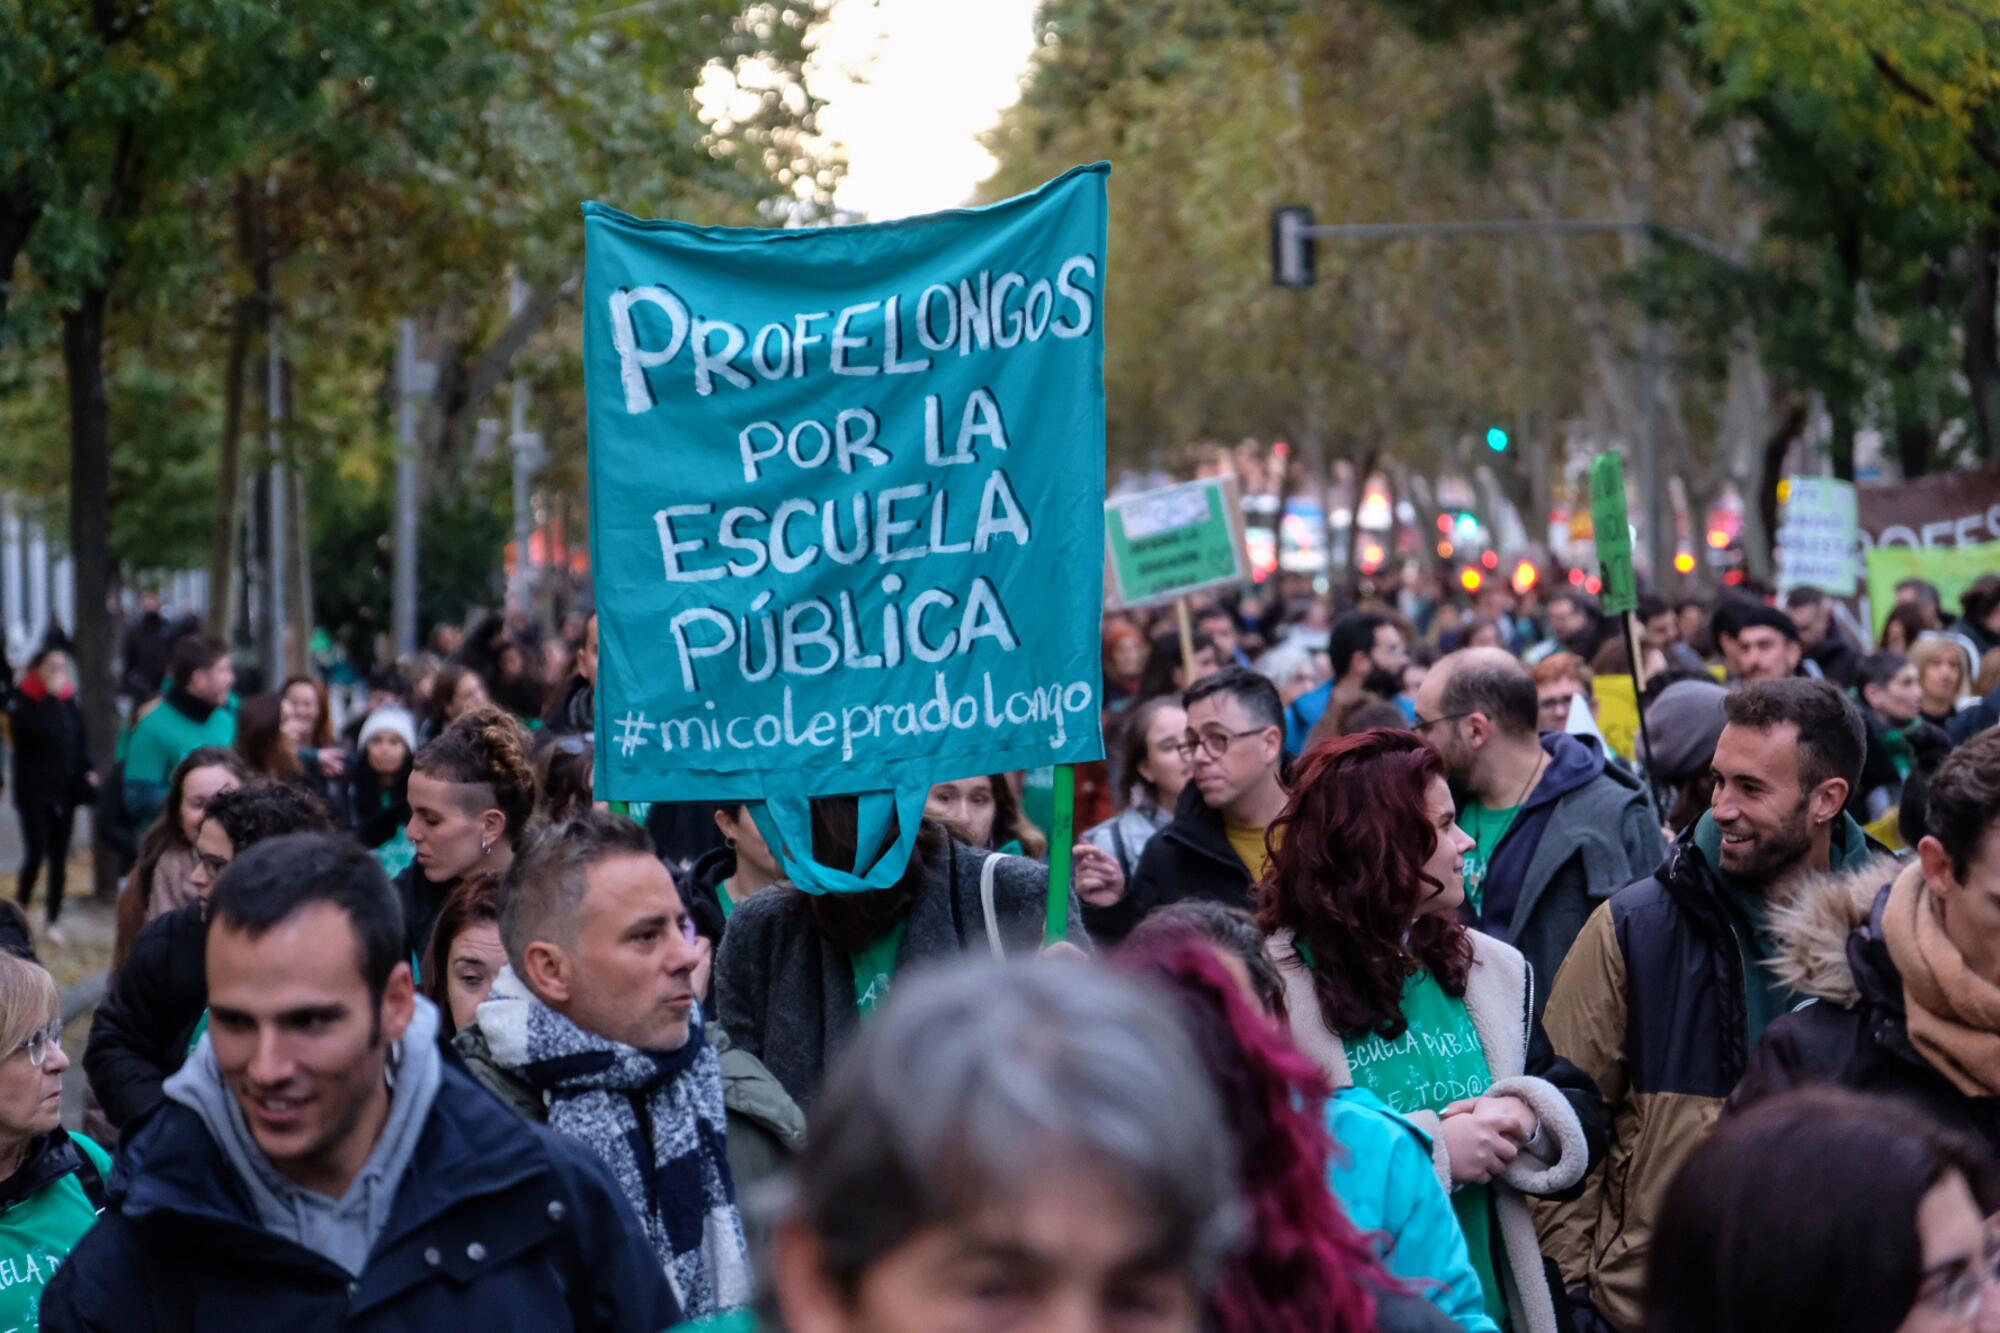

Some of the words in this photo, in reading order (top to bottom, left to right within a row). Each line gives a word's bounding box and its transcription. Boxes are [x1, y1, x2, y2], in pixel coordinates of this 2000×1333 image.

[609, 255, 1095, 414] PROFELONGOS
[738, 408, 890, 482] POR
[925, 387, 1007, 466] LA
[653, 470, 1030, 582] ESCUELA
[613, 671, 1092, 761] #micolepradolongo
